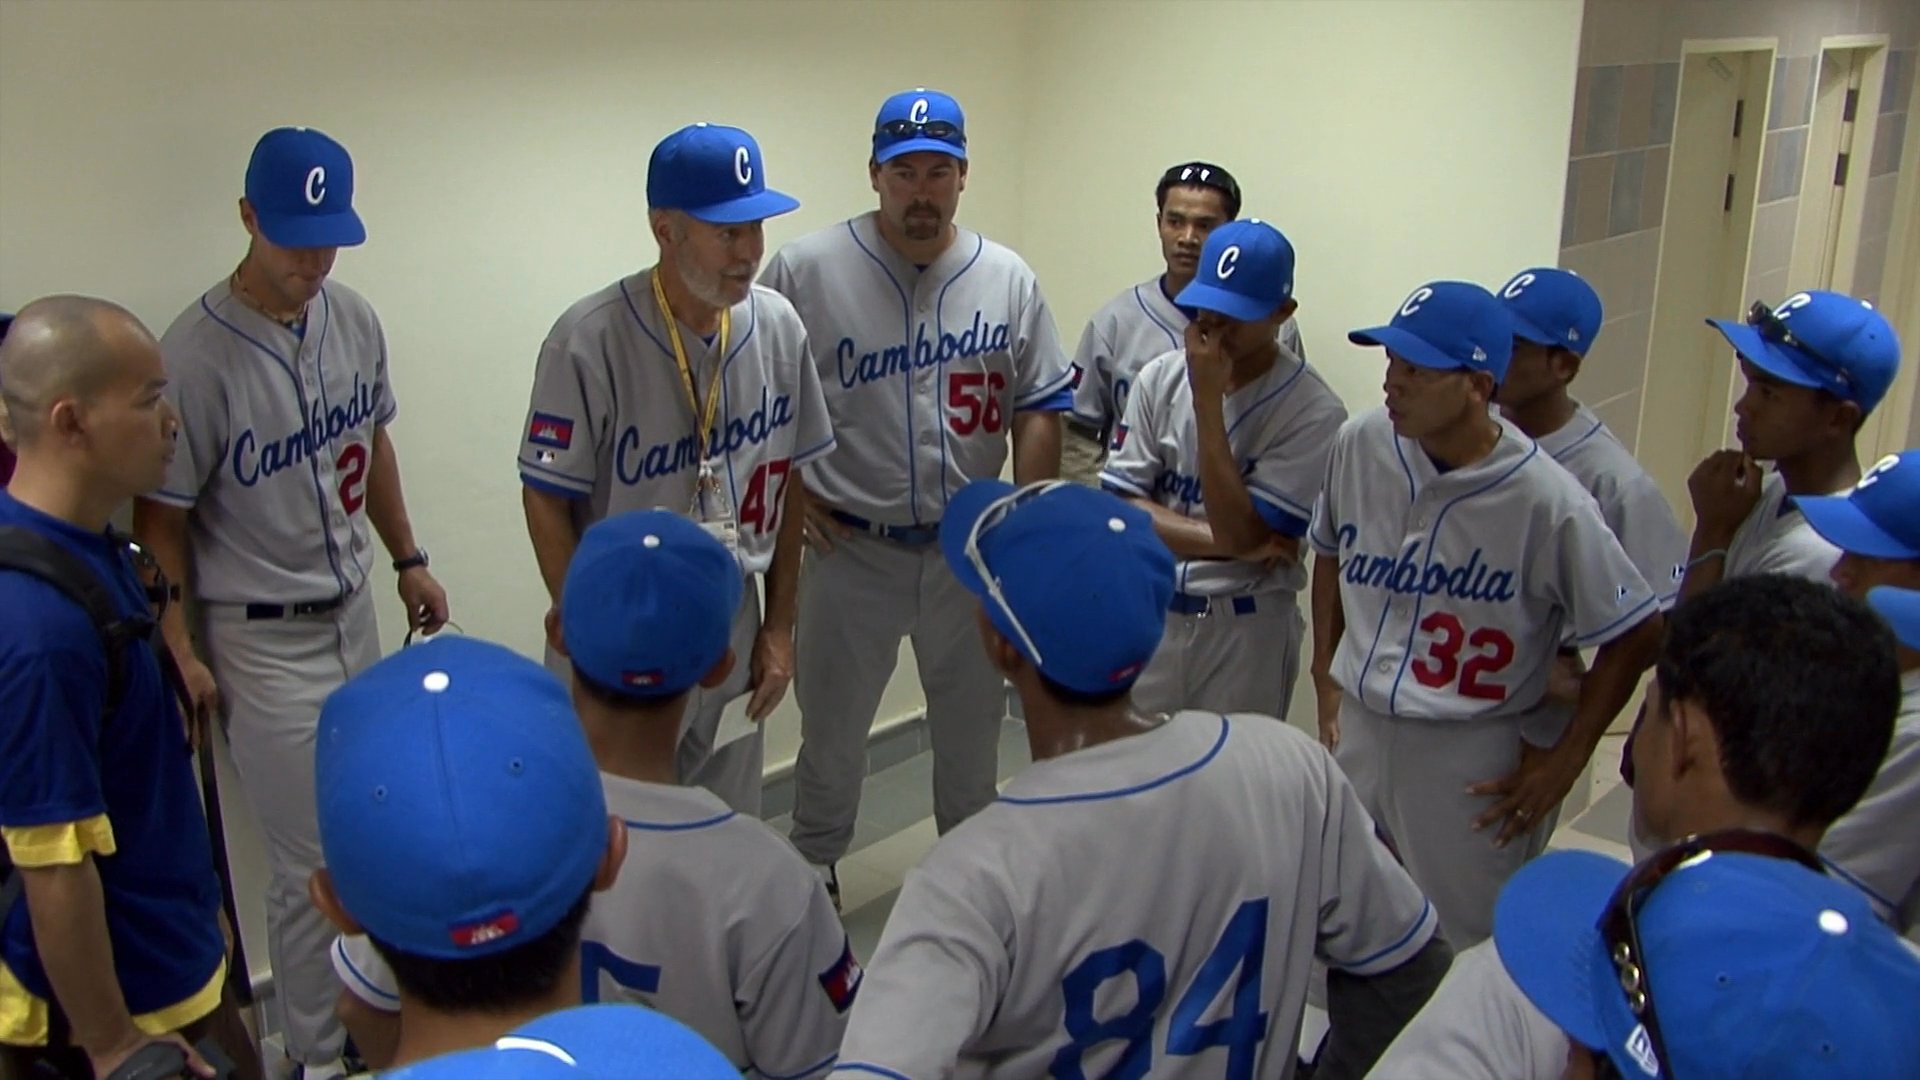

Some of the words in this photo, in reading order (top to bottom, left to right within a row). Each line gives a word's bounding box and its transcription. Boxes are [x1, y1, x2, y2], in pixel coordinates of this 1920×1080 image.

[909, 97, 928, 125] C
[735, 146, 752, 185] C
[305, 166, 326, 205] C
[1217, 245, 1240, 279] C
[1401, 287, 1433, 317] C
[1504, 273, 1536, 299] C
[1772, 292, 1811, 320] C
[837, 301, 1011, 390] Cambodia
[949, 372, 1005, 436] 56
[336, 442, 367, 517] 2
[1857, 454, 1900, 489] C
[740, 457, 791, 535] 47
[1411, 611, 1515, 700] 32
[1048, 896, 1269, 1080] 84
